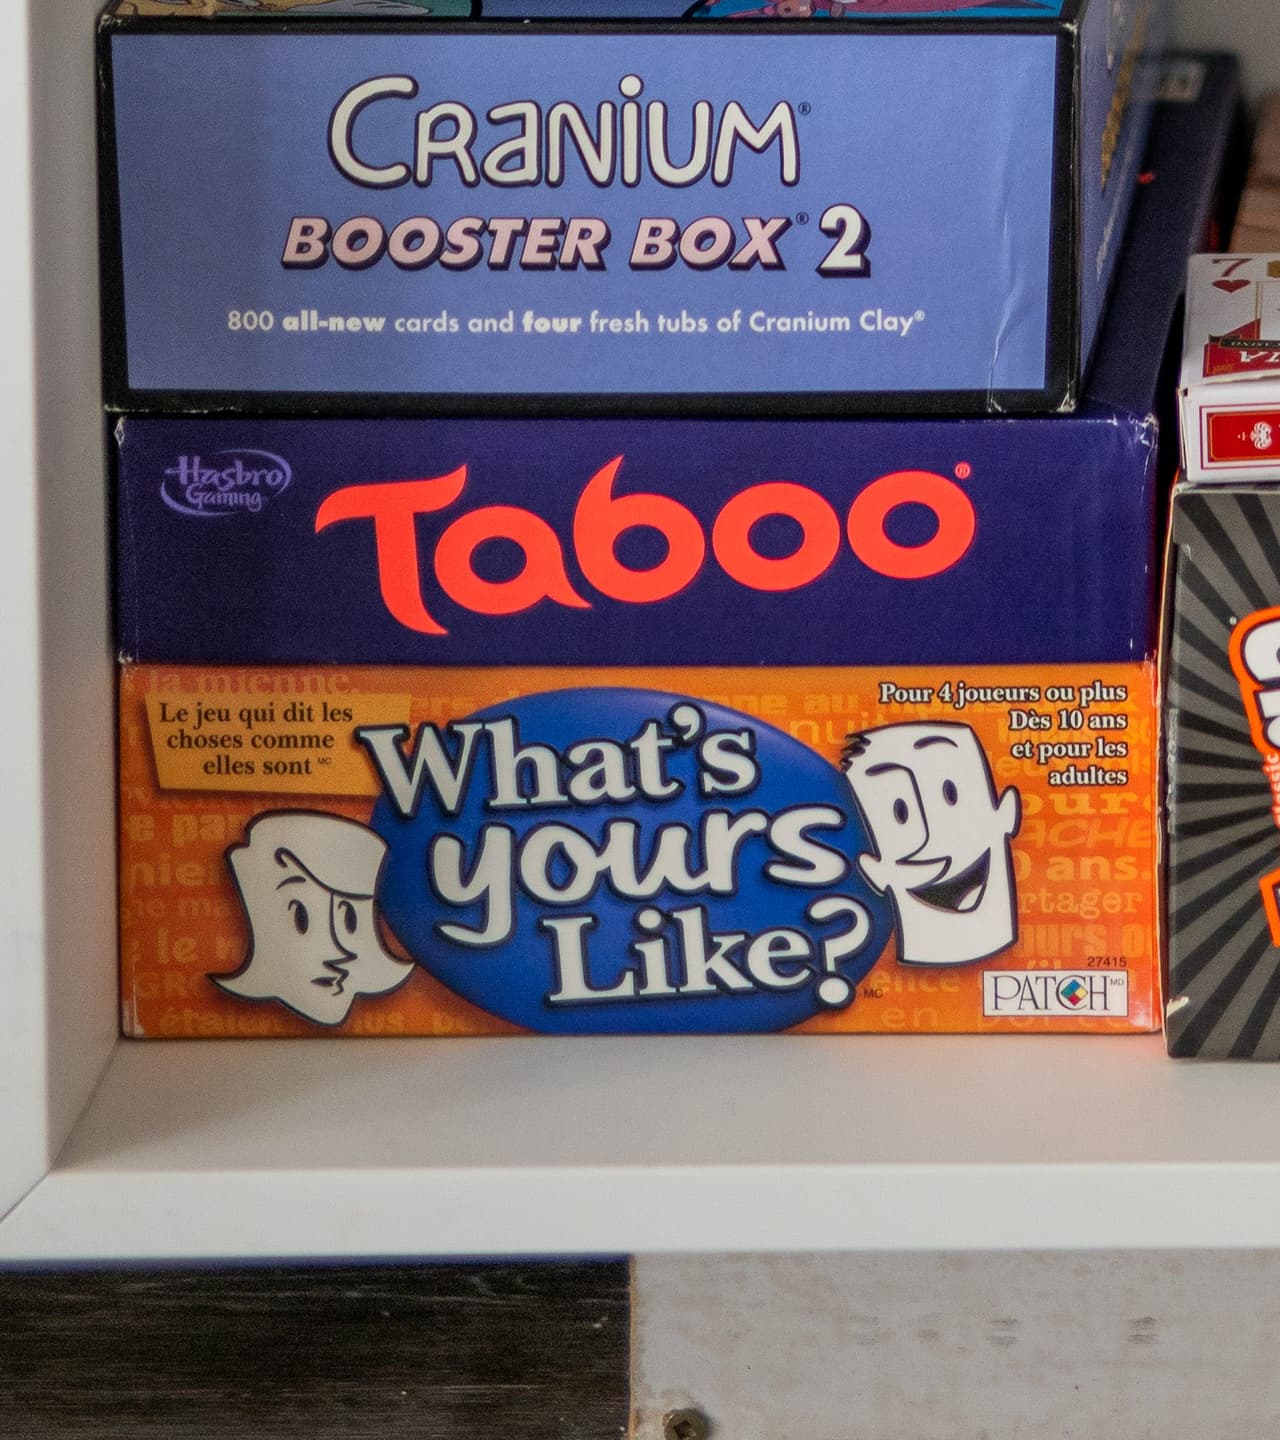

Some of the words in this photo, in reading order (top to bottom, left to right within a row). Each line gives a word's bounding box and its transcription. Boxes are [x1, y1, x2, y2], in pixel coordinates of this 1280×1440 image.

[281, 216, 611, 272] BOOSTER
[629, 216, 788, 270] BOX
[816, 203, 870, 277] 2
[228, 311, 274, 333] 800
[282, 311, 386, 333] all-new
[396, 311, 460, 333] cards
[469, 311, 514, 333] and
[522, 311, 581, 333] four
[590, 311, 648, 333] fresh
[658, 311, 708, 333] tubs
[716, 311, 741, 333] of
[749, 309, 850, 333] Cranium
[315, 455, 975, 635] Taboo
[880, 683, 934, 702] Pour
[939, 683, 952, 702] 4
[955, 684, 1041, 708] joueurs
[1045, 686, 1074, 701] ou
[1077, 683, 1128, 707] plus
[1009, 710, 1051, 730] Dès
[1056, 710, 1082, 729] 10
[1089, 714, 1128, 729] ans
[354, 703, 760, 819] What's
[431, 804, 849, 948] yours
[541, 895, 873, 1009] Like?
[1087, 956, 1127, 968] 27415
[992, 976, 1110, 1011] PATCH
